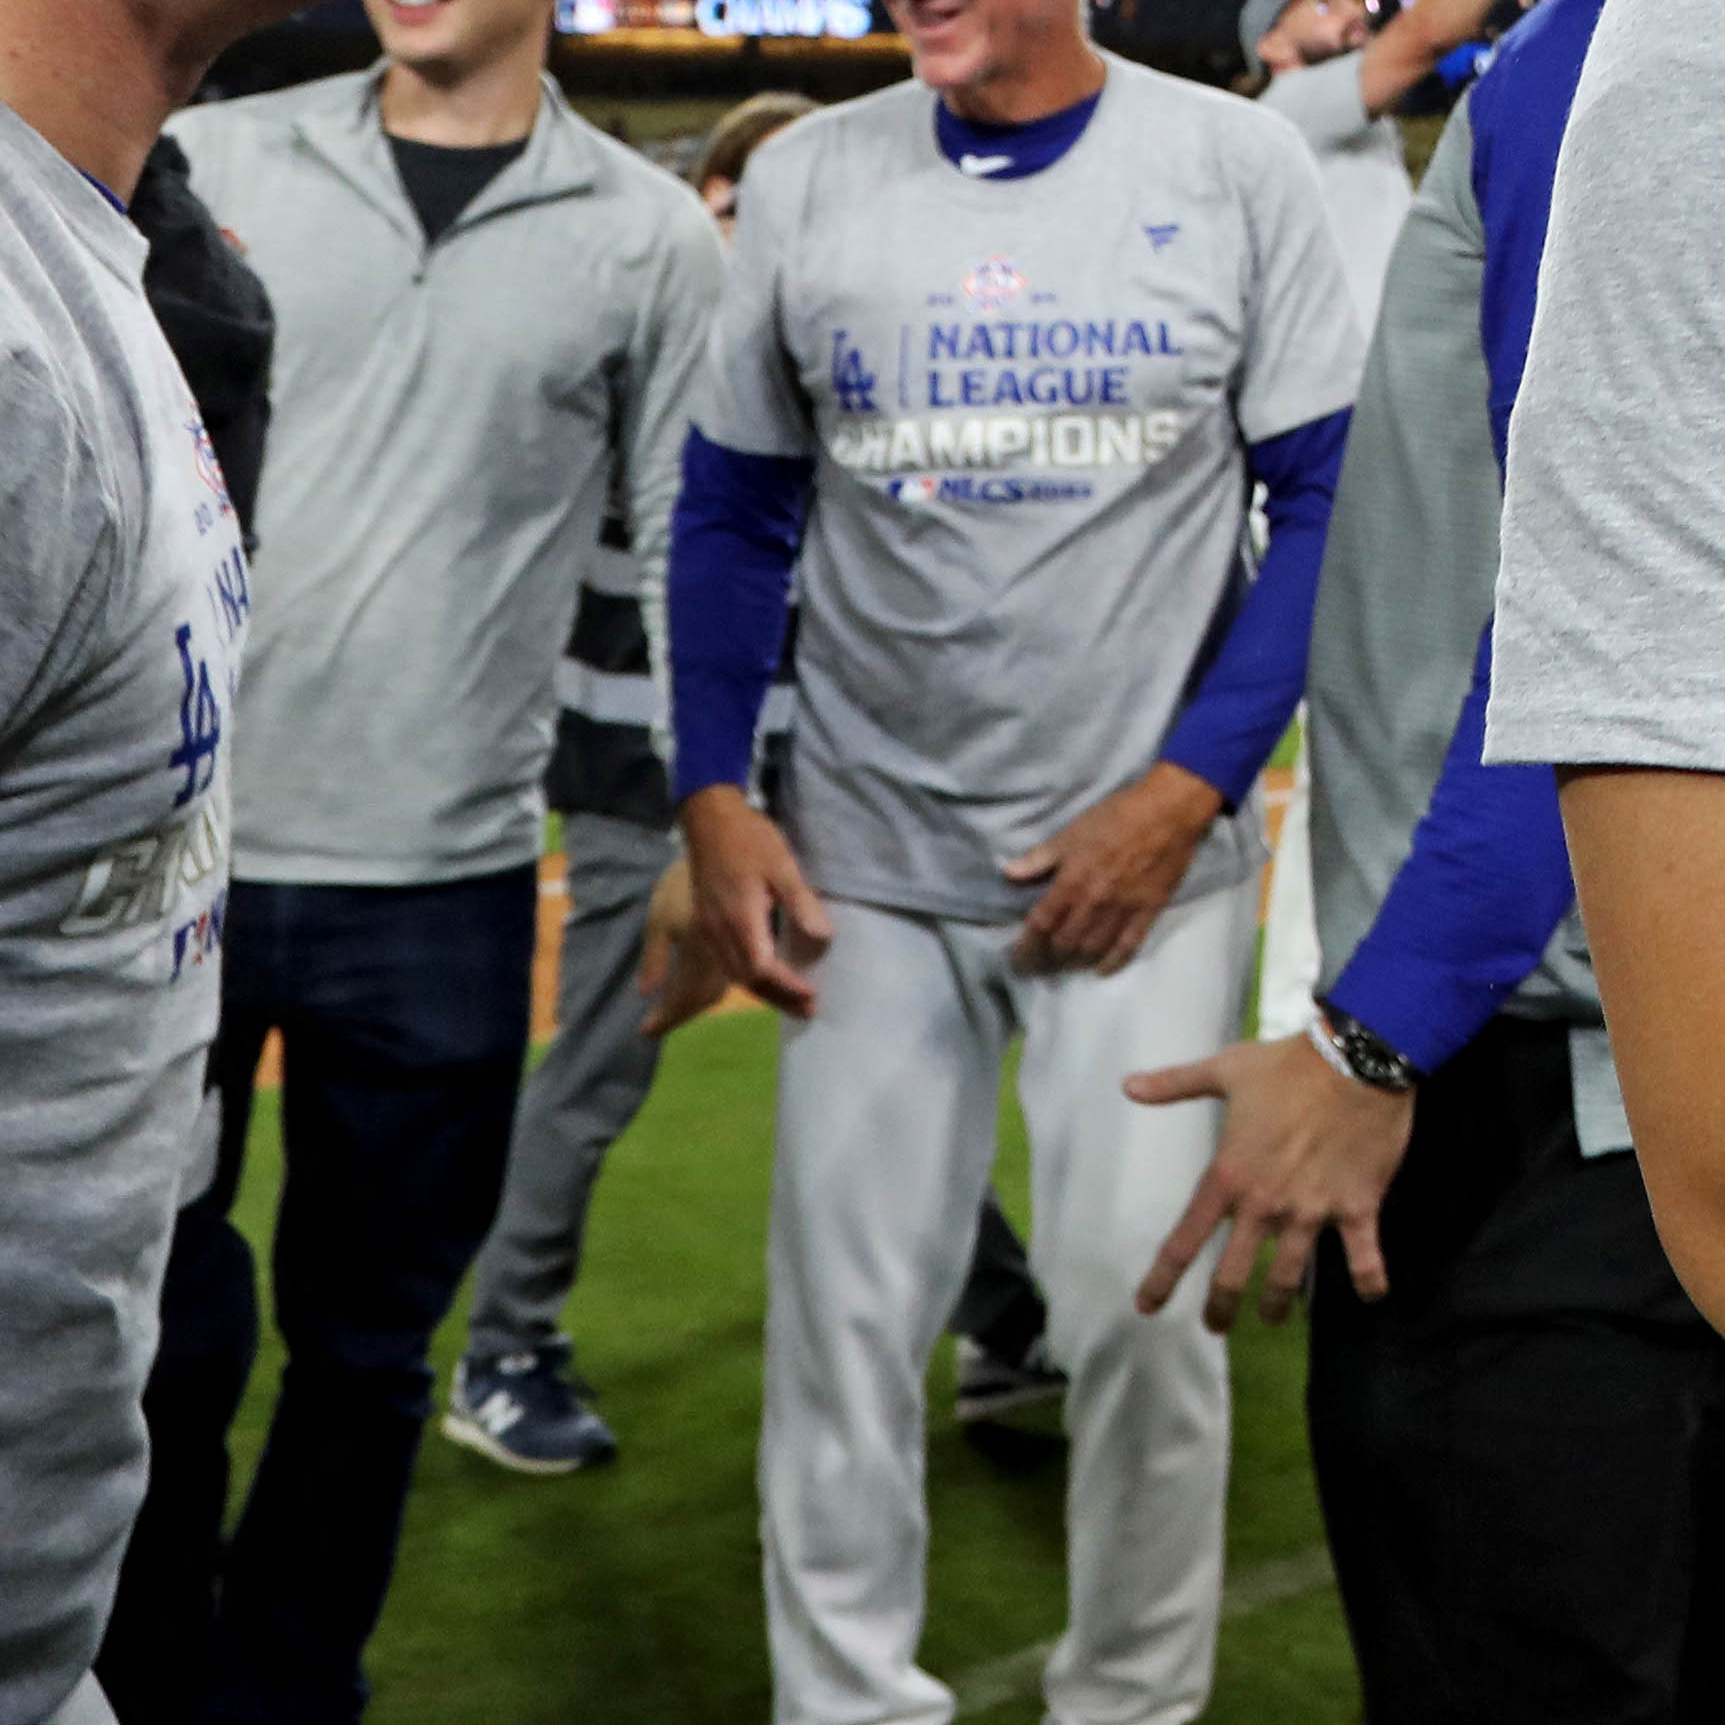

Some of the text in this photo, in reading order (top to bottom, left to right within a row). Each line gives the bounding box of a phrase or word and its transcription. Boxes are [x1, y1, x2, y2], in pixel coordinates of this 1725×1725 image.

[928, 320, 1184, 360] NATIONAL
[928, 365, 1128, 408] LEAGUE
[939, 475, 1023, 503] NLCS
